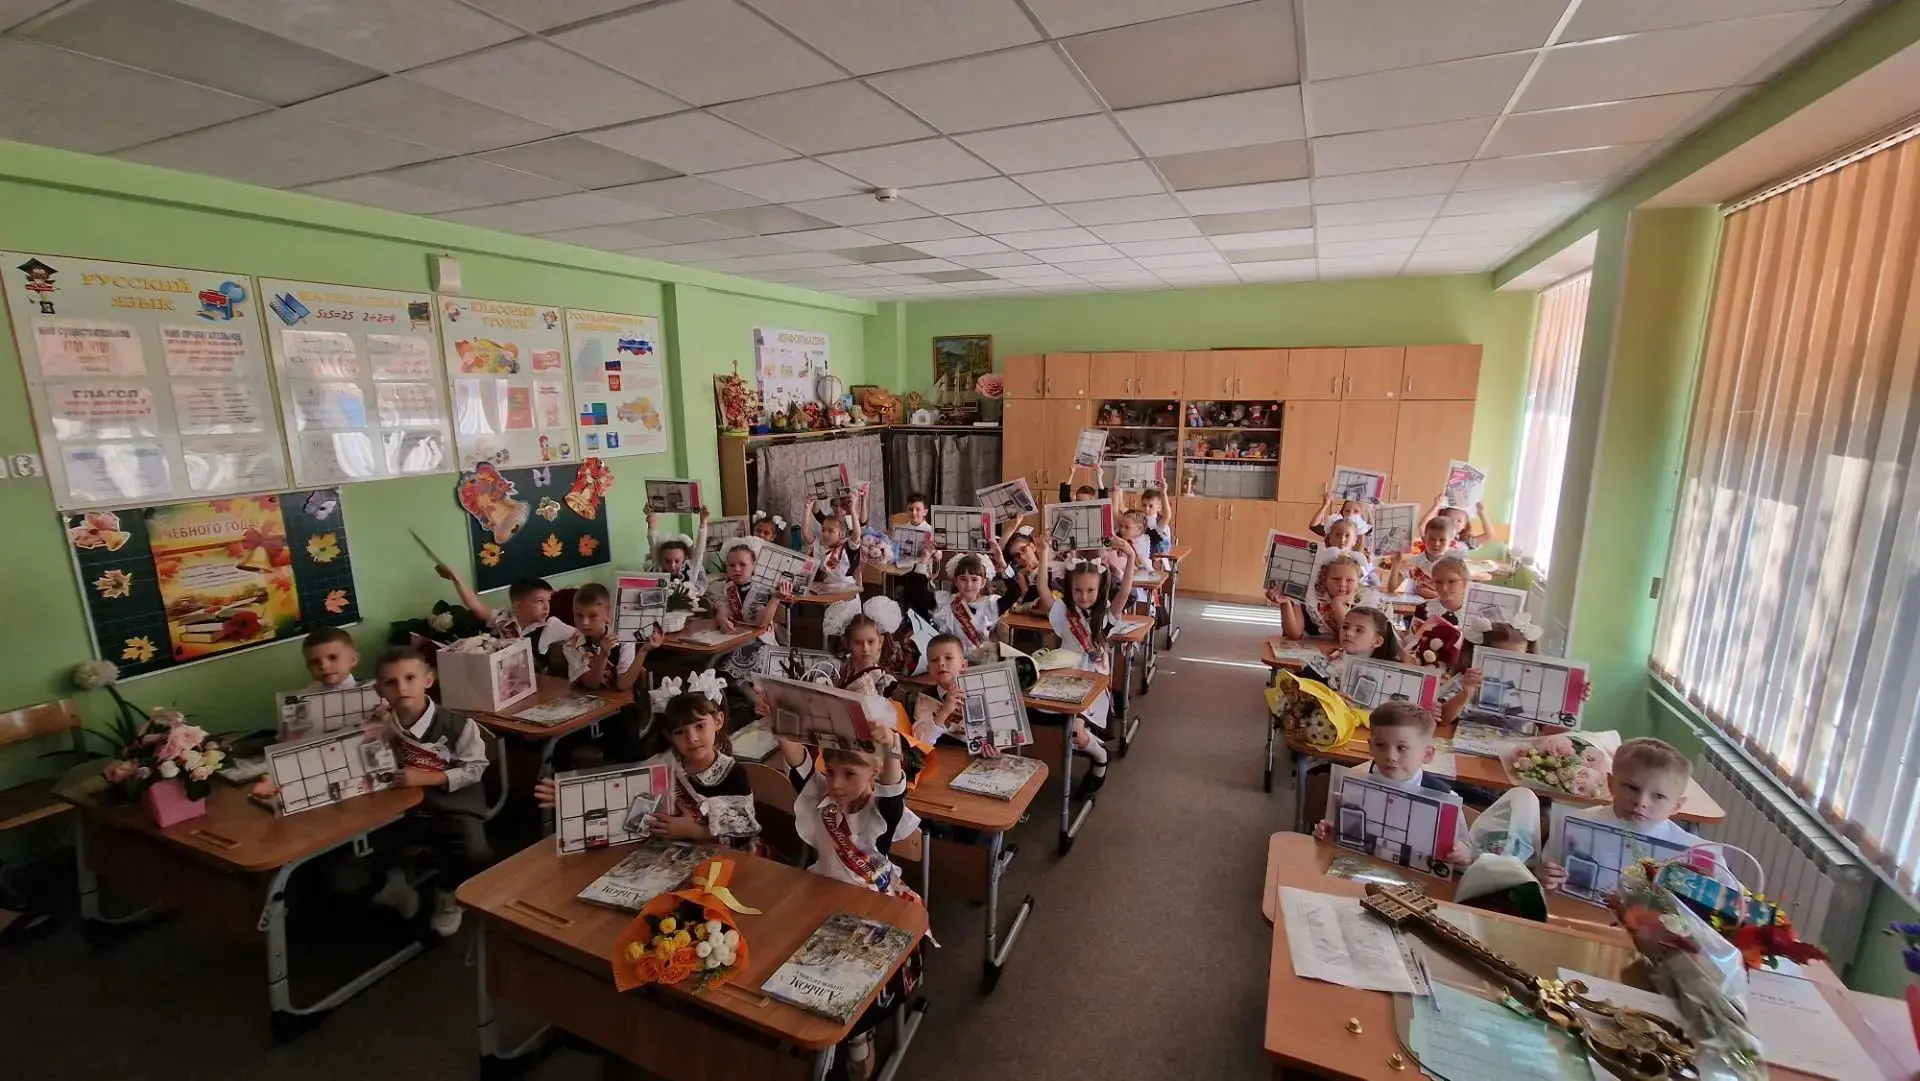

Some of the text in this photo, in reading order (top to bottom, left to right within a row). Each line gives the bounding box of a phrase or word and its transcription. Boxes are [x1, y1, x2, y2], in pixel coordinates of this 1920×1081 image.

[81, 272, 193, 294] РУССКИЙ
[110, 296, 175, 311] ЯЗЫК
[72, 389, 139, 399] ГЛАГОЛ
